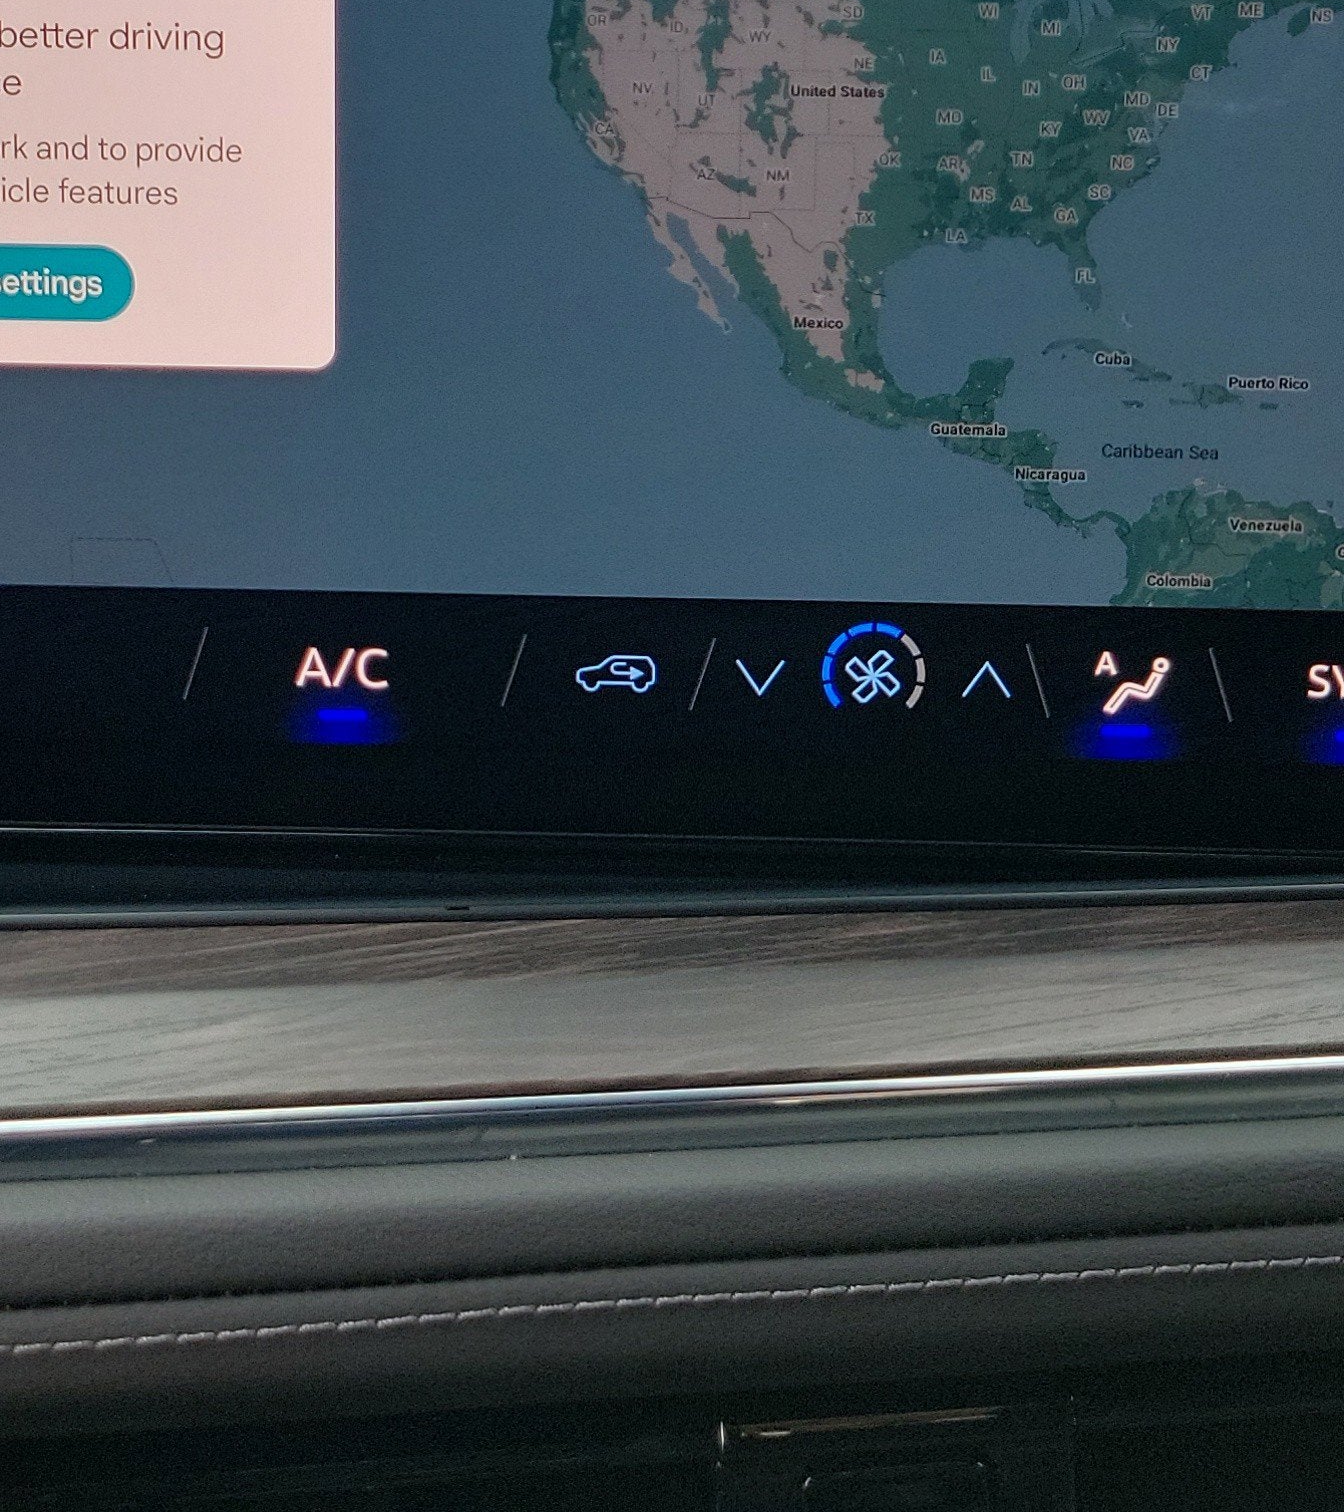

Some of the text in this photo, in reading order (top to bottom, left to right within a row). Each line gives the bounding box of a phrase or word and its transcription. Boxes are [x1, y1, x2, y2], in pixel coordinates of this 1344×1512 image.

[843, 6, 863, 20] SD
[978, 4, 998, 18] WI
[1191, 6, 1212, 20] VT
[1239, 2, 1262, 17] ME
[1312, 9, 1333, 23] NS
[587, 13, 607, 27] OR
[670, 20, 683, 34] ID
[1041, 21, 1061, 36] MI
[109, 21, 226, 59] driving
[749, 29, 771, 43] WY
[1157, 38, 1179, 52] NY
[854, 57, 874, 70] NE
[930, 50, 946, 64] IA
[980, 68, 995, 81] IL
[1190, 66, 1212, 80] CT
[633, 82, 652, 95] NV
[1023, 81, 1040, 95] IN
[1063, 75, 1085, 90] OH
[791, 84, 884, 99] United States
[698, 94, 715, 108] UT
[1124, 92, 1150, 107] MD
[937, 109, 962, 124] MO
[1157, 103, 1178, 117] DE
[1084, 110, 1110, 125] WV
[595, 122, 614, 135] CA
[1040, 122, 1061, 136] KY
[1128, 128, 1150, 142] VA
[36, 134, 90, 163] and
[98, 136, 127, 162] to
[135, 135, 242, 169] provide
[879, 153, 900, 167] OK
[939, 156, 959, 170] AR
[1012, 152, 1033, 167] TN
[1111, 155, 1134, 170] NC
[697, 168, 715, 182] AZ
[766, 169, 790, 182] NM
[58, 176, 179, 207] features
[970, 187, 995, 202] MS
[1089, 185, 1111, 200] SC
[1011, 197, 1032, 211] AL
[855, 212, 875, 225] TX
[1055, 208, 1076, 223] GA
[946, 229, 967, 243] LA
[1076, 269, 1095, 283] FL
[794, 316, 844, 330] Mexico
[1095, 352, 1131, 367] Cuba
[1228, 377, 1309, 391] Puerto Rico
[931, 422, 1006, 438] Guatemala
[1102, 444, 1219, 461] Caribbean Sea
[1015, 467, 1086, 483] Nicaragua
[1230, 518, 1302, 535] Venezuela
[1146, 573, 1212, 589] Colombia
[294, 647, 390, 692] A/C
